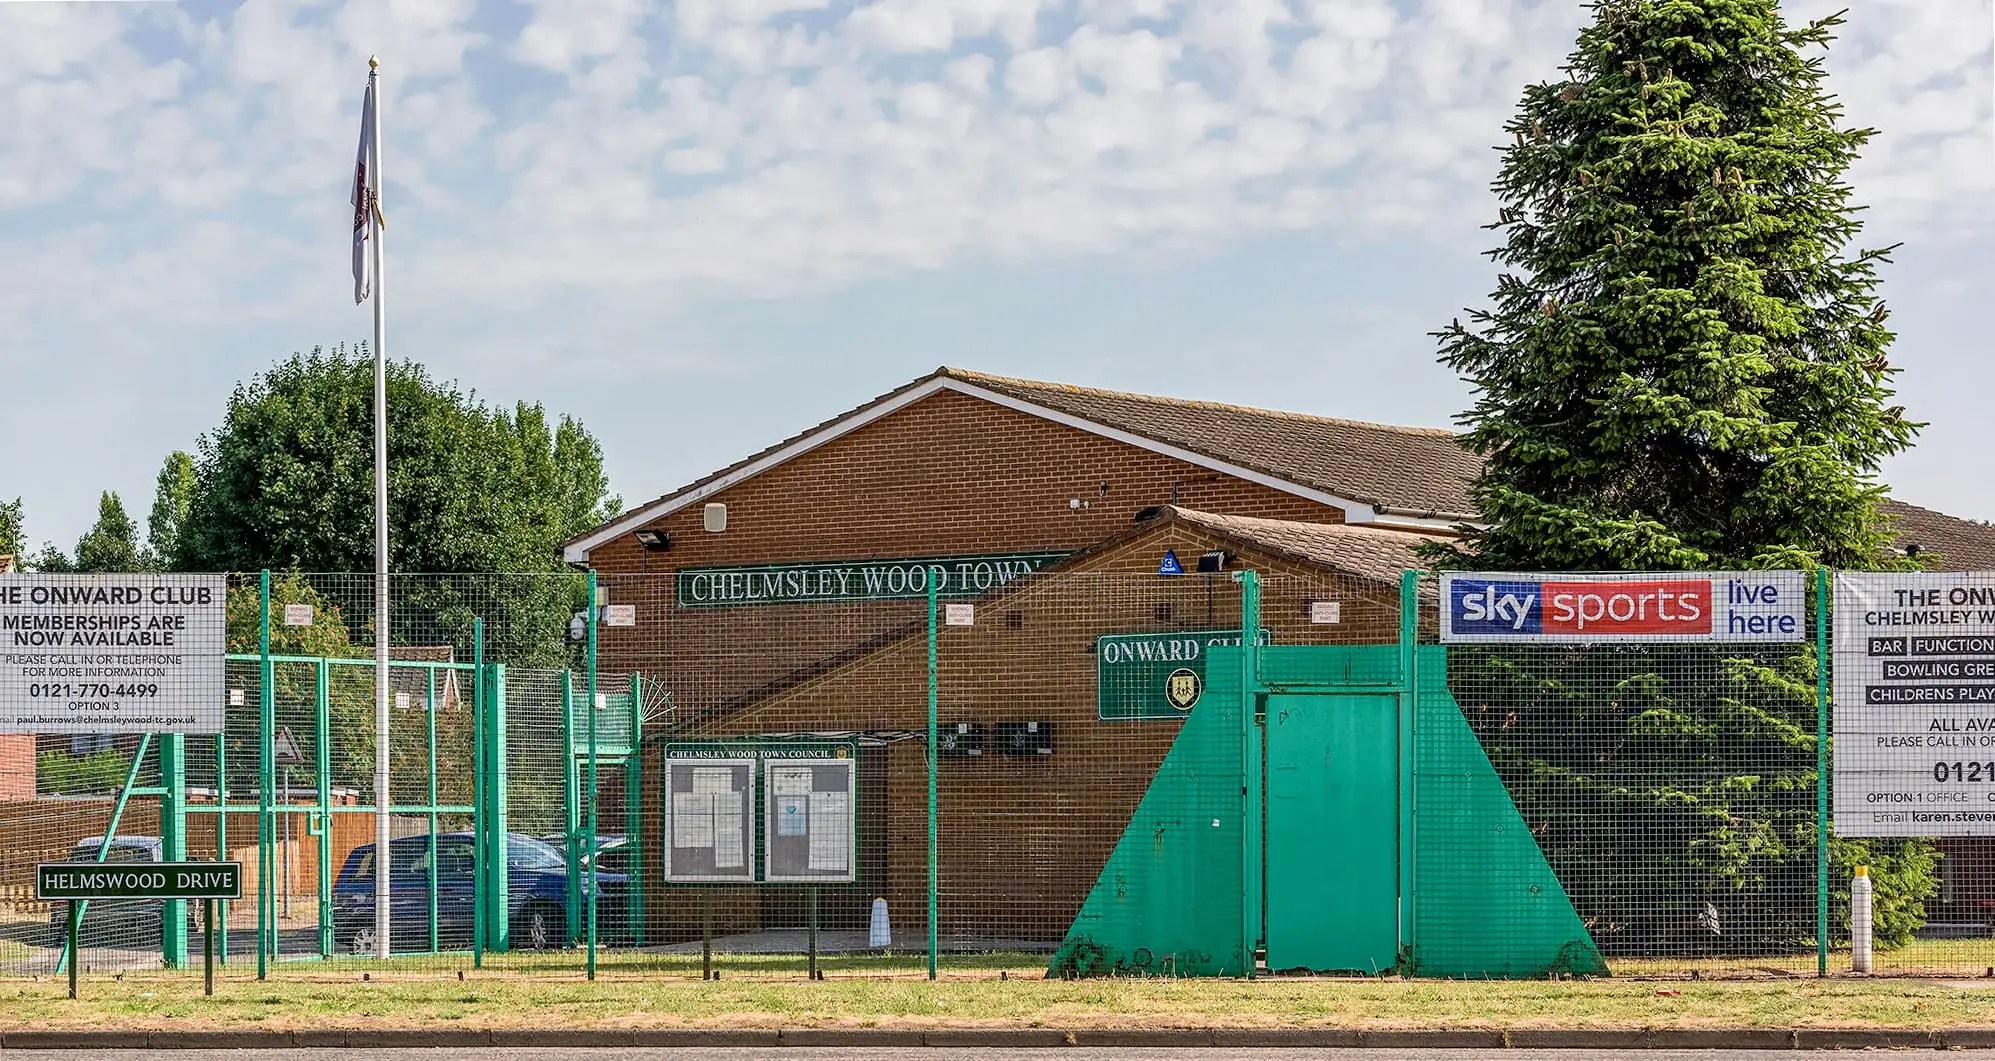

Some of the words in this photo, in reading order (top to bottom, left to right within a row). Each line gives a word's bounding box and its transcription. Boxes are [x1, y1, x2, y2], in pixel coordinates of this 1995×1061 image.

[691, 567, 853, 601] CHELMSLEY
[861, 564, 947, 594] WOOD
[30, 586, 142, 605] ONWARD
[151, 586, 212, 605] CLUB
[1728, 579, 1778, 604] live
[1894, 589, 1940, 607] THE
[1462, 585, 1535, 630] sky
[1553, 588, 1700, 630] sports
[3, 615, 141, 630] MEMBERSHIPS
[147, 615, 185, 630] ARE
[1728, 609, 1795, 634] here
[1865, 611, 1972, 626] CHELMSLEY
[15, 631, 64, 646] NOW
[70, 631, 174, 646] AVAILABLE
[1872, 640, 1903, 653] BAR
[1916, 639, 1994, 652] FUNCTION
[1104, 639, 1199, 664] ONWARD
[6, 655, 46, 665] PLEASE
[50, 655, 78, 665] CALL
[81, 655, 93, 665] IN
[96, 655, 113, 665] OR
[116, 655, 182, 665] TELEPHONE
[23, 667, 46, 677] FOR
[48, 667, 82, 677] MORE
[85, 667, 166, 677] INFORMATION
[1887, 663, 1959, 677] BOWLING
[1964, 663, 1995, 676] GRE
[30, 683, 158, 698] 0121-770-4499
[1870, 687, 1954, 701] CHILDRENS
[1960, 687, 1995, 700] PLAY
[68, 701, 110, 711] OPTION
[113, 701, 120, 711] 3
[17, 715, 196, 726] paul.burrows@chelmsleywood-tc.gov.uk
[1929, 718, 1960, 731] ALL
[1877, 736, 1922, 747] PLEASE
[1926, 736, 1959, 747] CALL
[1962, 736, 1976, 746] IN
[669, 750, 726, 759] CHELMSLEY
[728, 750, 757, 759] WOOD
[759, 750, 786, 759] TOWN
[789, 750, 831, 758] COUNCIL
[1934, 761, 1995, 782] 0121
[1866, 793, 1913, 803] OPTION
[1916, 793, 1922, 803] 1
[1926, 792, 1968, 803] OFFICE
[1873, 811, 1908, 823] Email
[1912, 811, 1995, 823] karen.steve
[45, 873, 166, 889] HELMSWOOD
[177, 873, 233, 888] DRIVE
